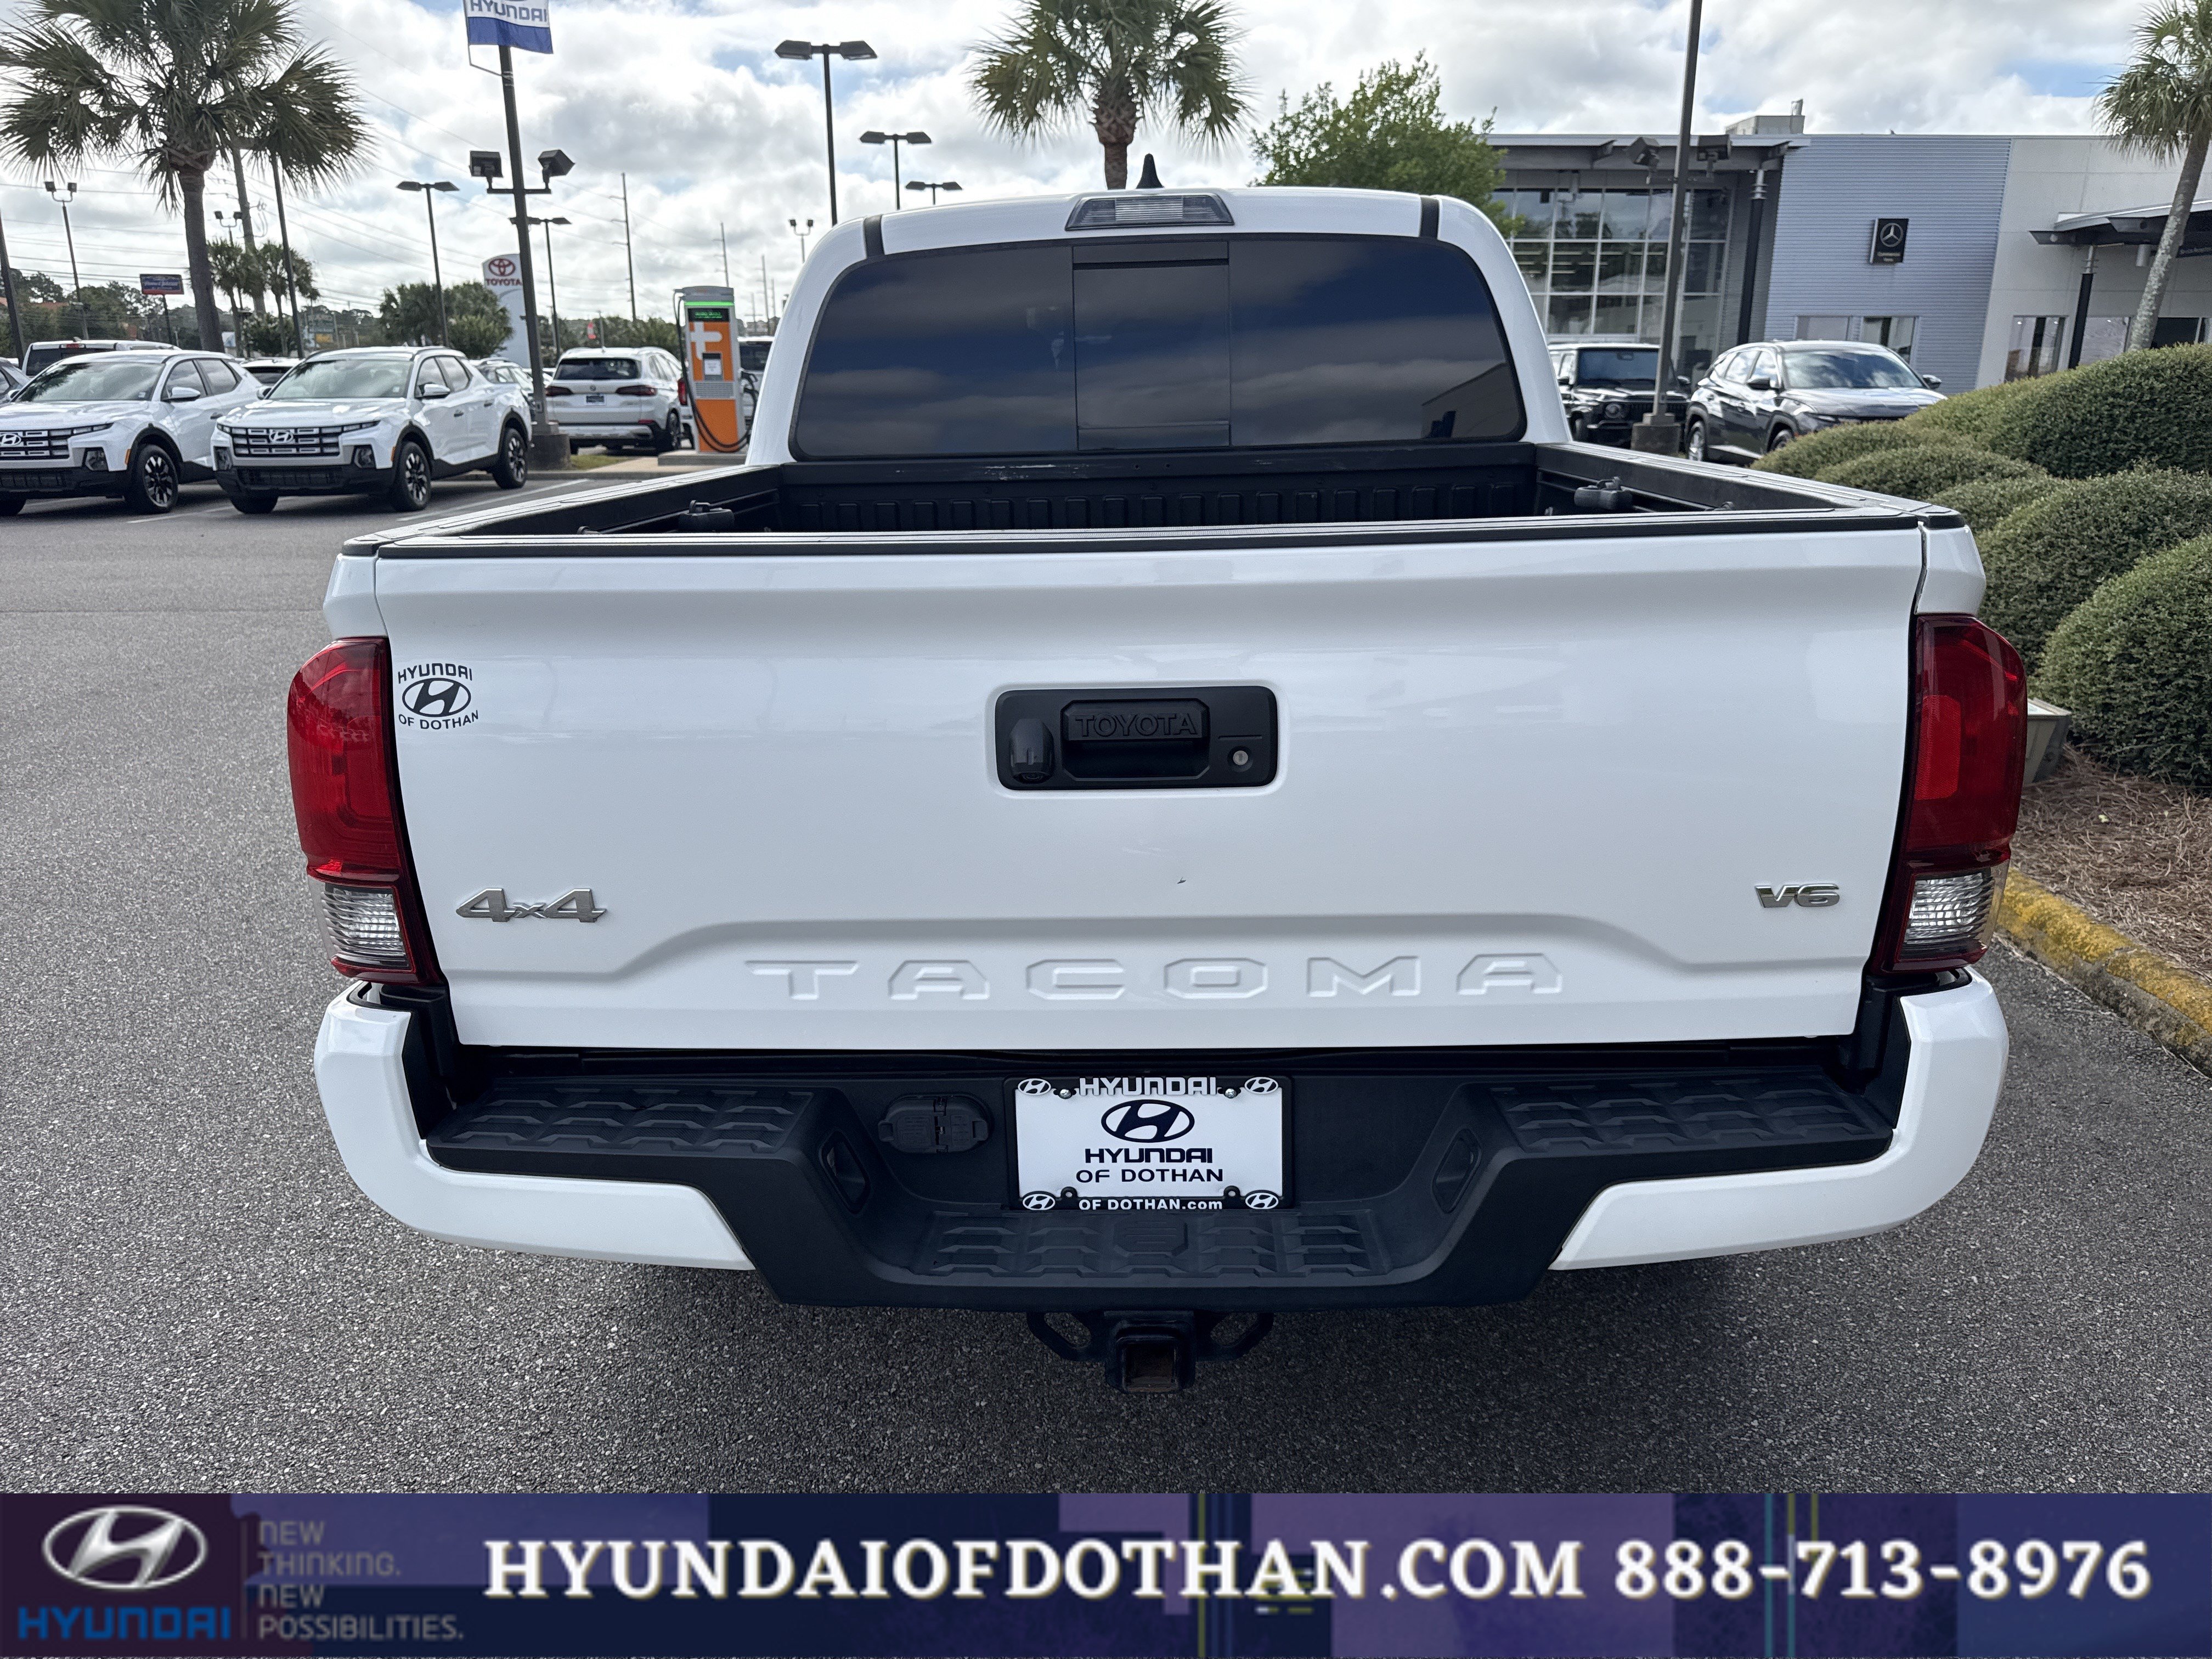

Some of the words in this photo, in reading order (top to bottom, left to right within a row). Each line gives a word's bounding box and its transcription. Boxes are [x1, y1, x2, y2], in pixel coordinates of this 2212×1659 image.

[470, 0, 547, 22] HYUNDAI
[486, 278, 523, 286] TOYOTA
[398, 663, 472, 684] HYUNDAI
[398, 714, 415, 726] OF
[420, 709, 479, 730] DOTHAN
[1075, 713, 1198, 737] TOYOTA
[456, 888, 607, 923] 4x4
[1754, 883, 1840, 908] V6
[744, 953, 1563, 1001] TACOMA
[1079, 1076, 1217, 1096] HYUNDAI
[1085, 1148, 1213, 1164] HYUNDAI
[1076, 1169, 1110, 1183] OF
[1121, 1169, 1223, 1182] DOTHAN
[1079, 1199, 1102, 1210] OF
[1108, 1198, 1222, 1210] DOTHAN.com
